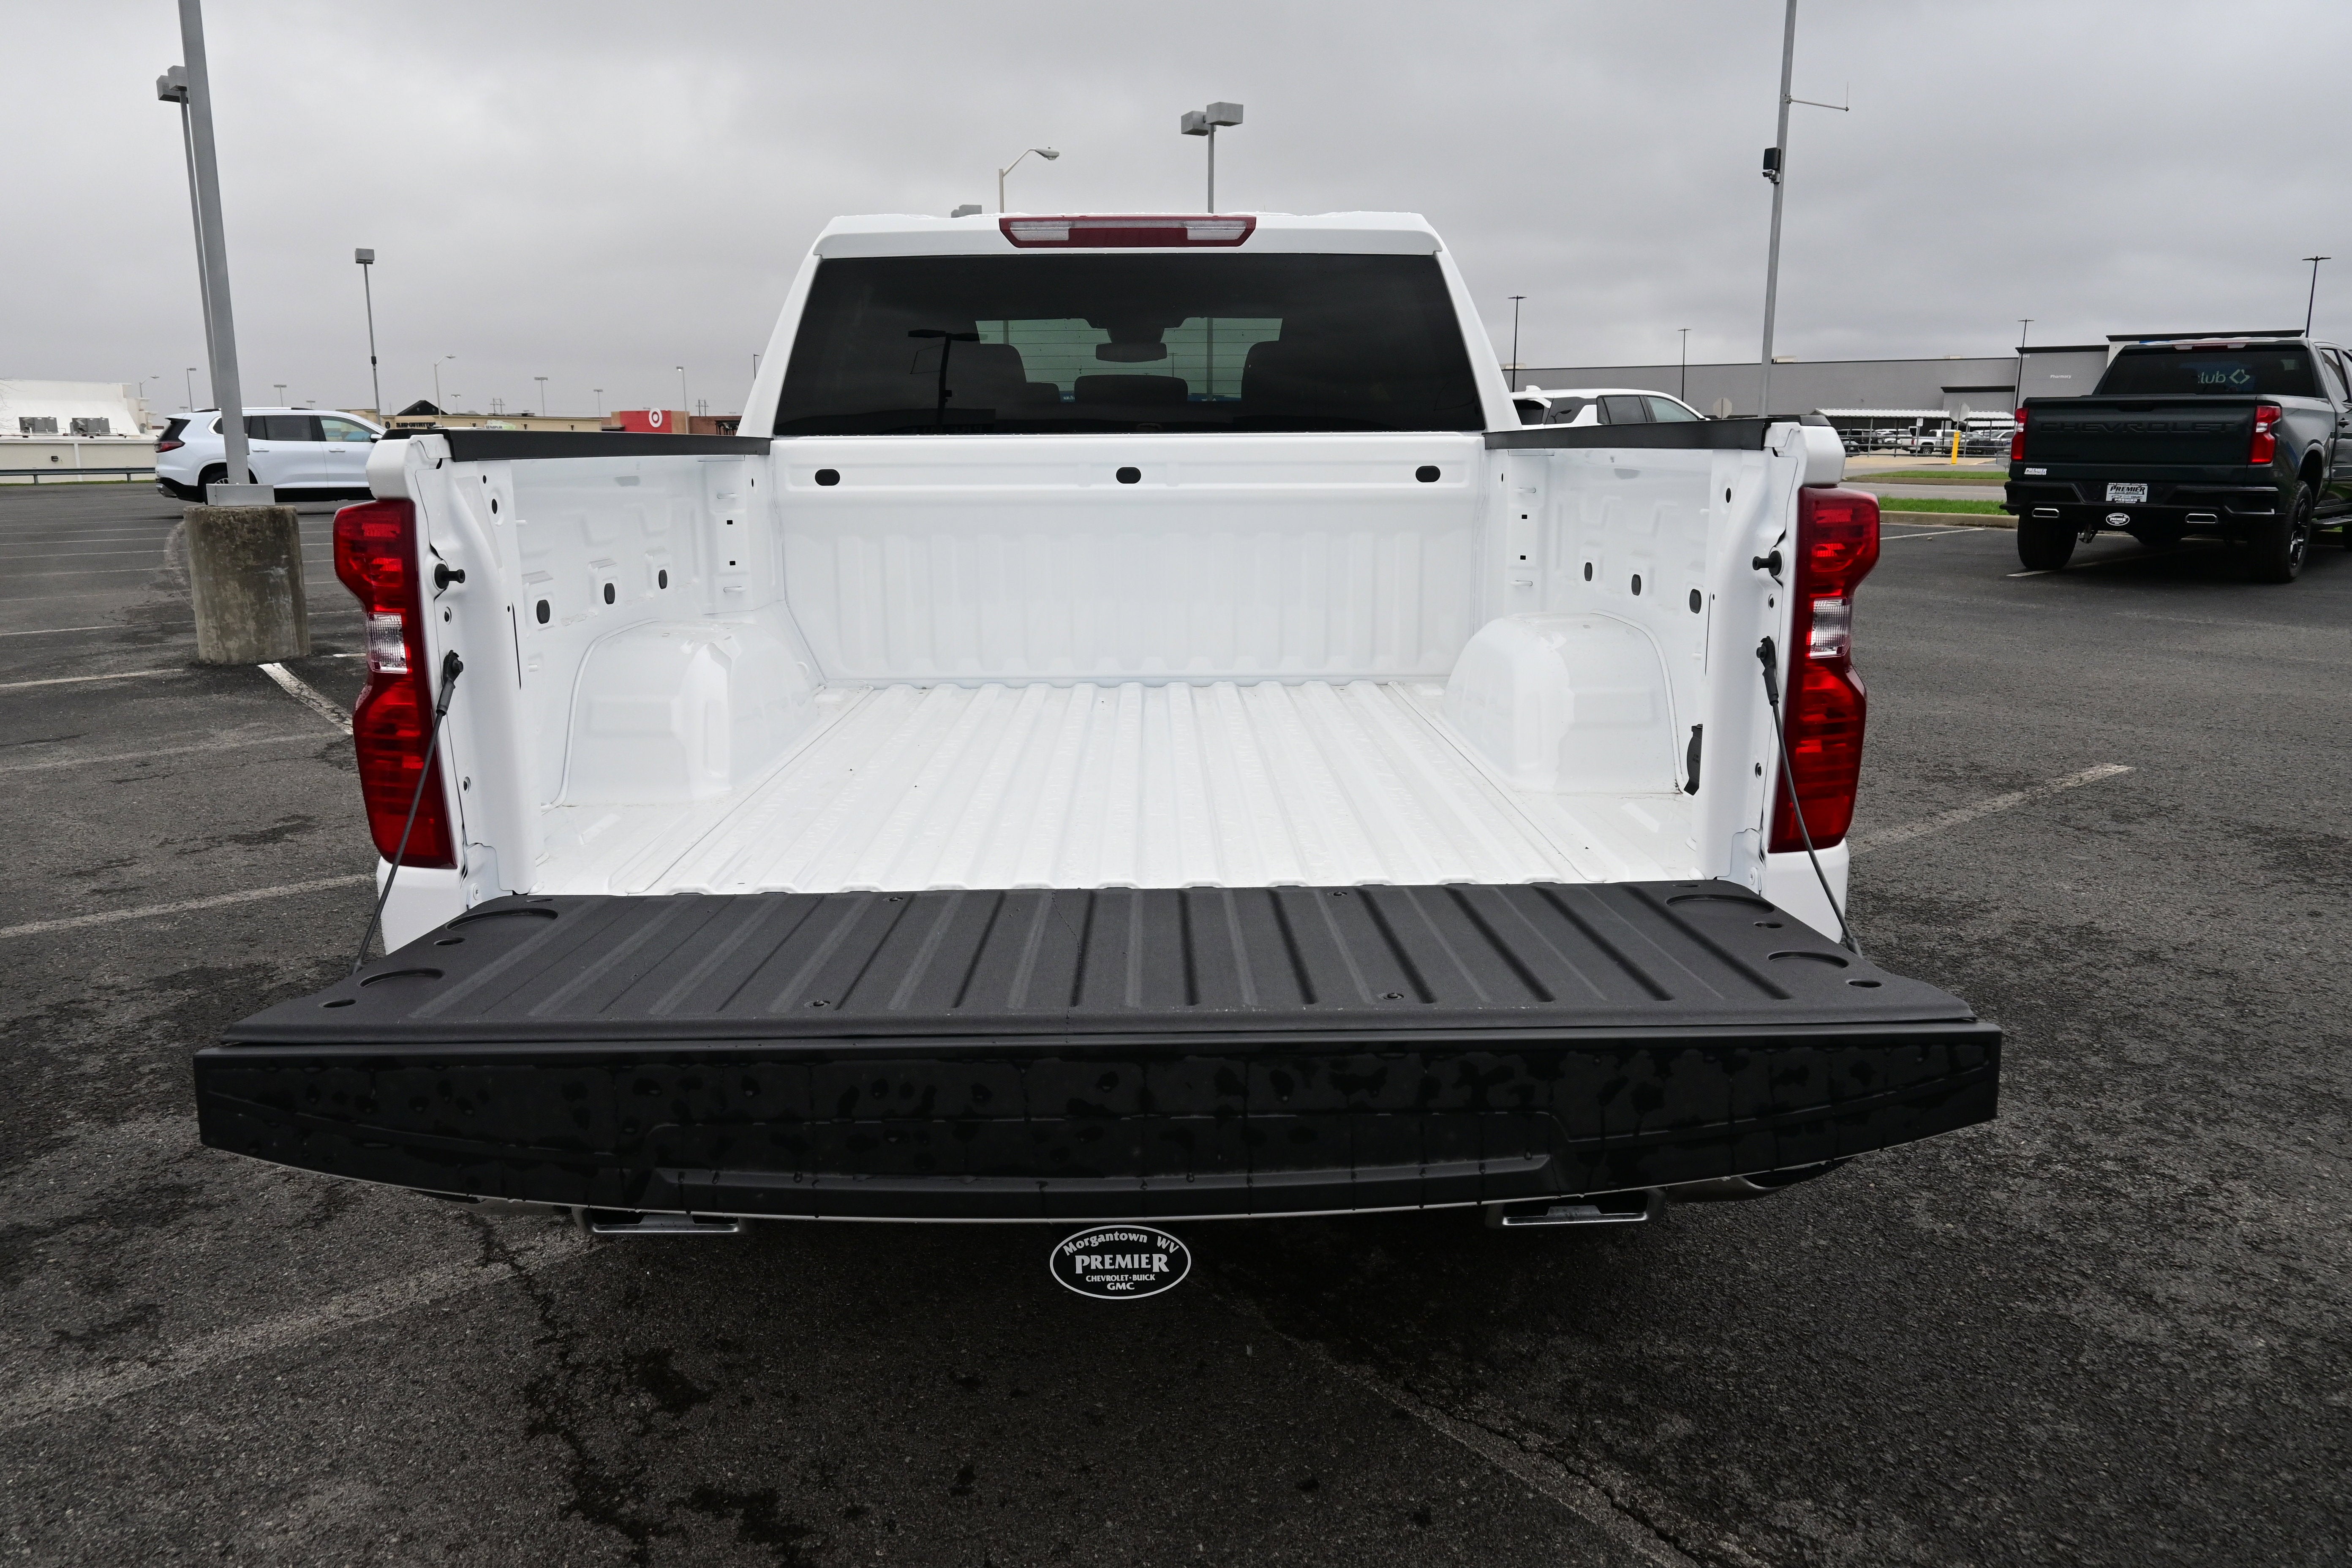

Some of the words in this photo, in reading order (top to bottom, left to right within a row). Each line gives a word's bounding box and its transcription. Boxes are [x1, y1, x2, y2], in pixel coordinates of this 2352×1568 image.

[2198, 370, 2226, 384] lub
[2040, 422, 2235, 433] CHEVROLET
[2110, 486, 2145, 494] PREMIER
[1063, 1231, 1147, 1256] Morgantown
[1157, 1236, 1179, 1254] WV
[1075, 1254, 1169, 1274] PREMIER
[1107, 1282, 1135, 1290] GMC
